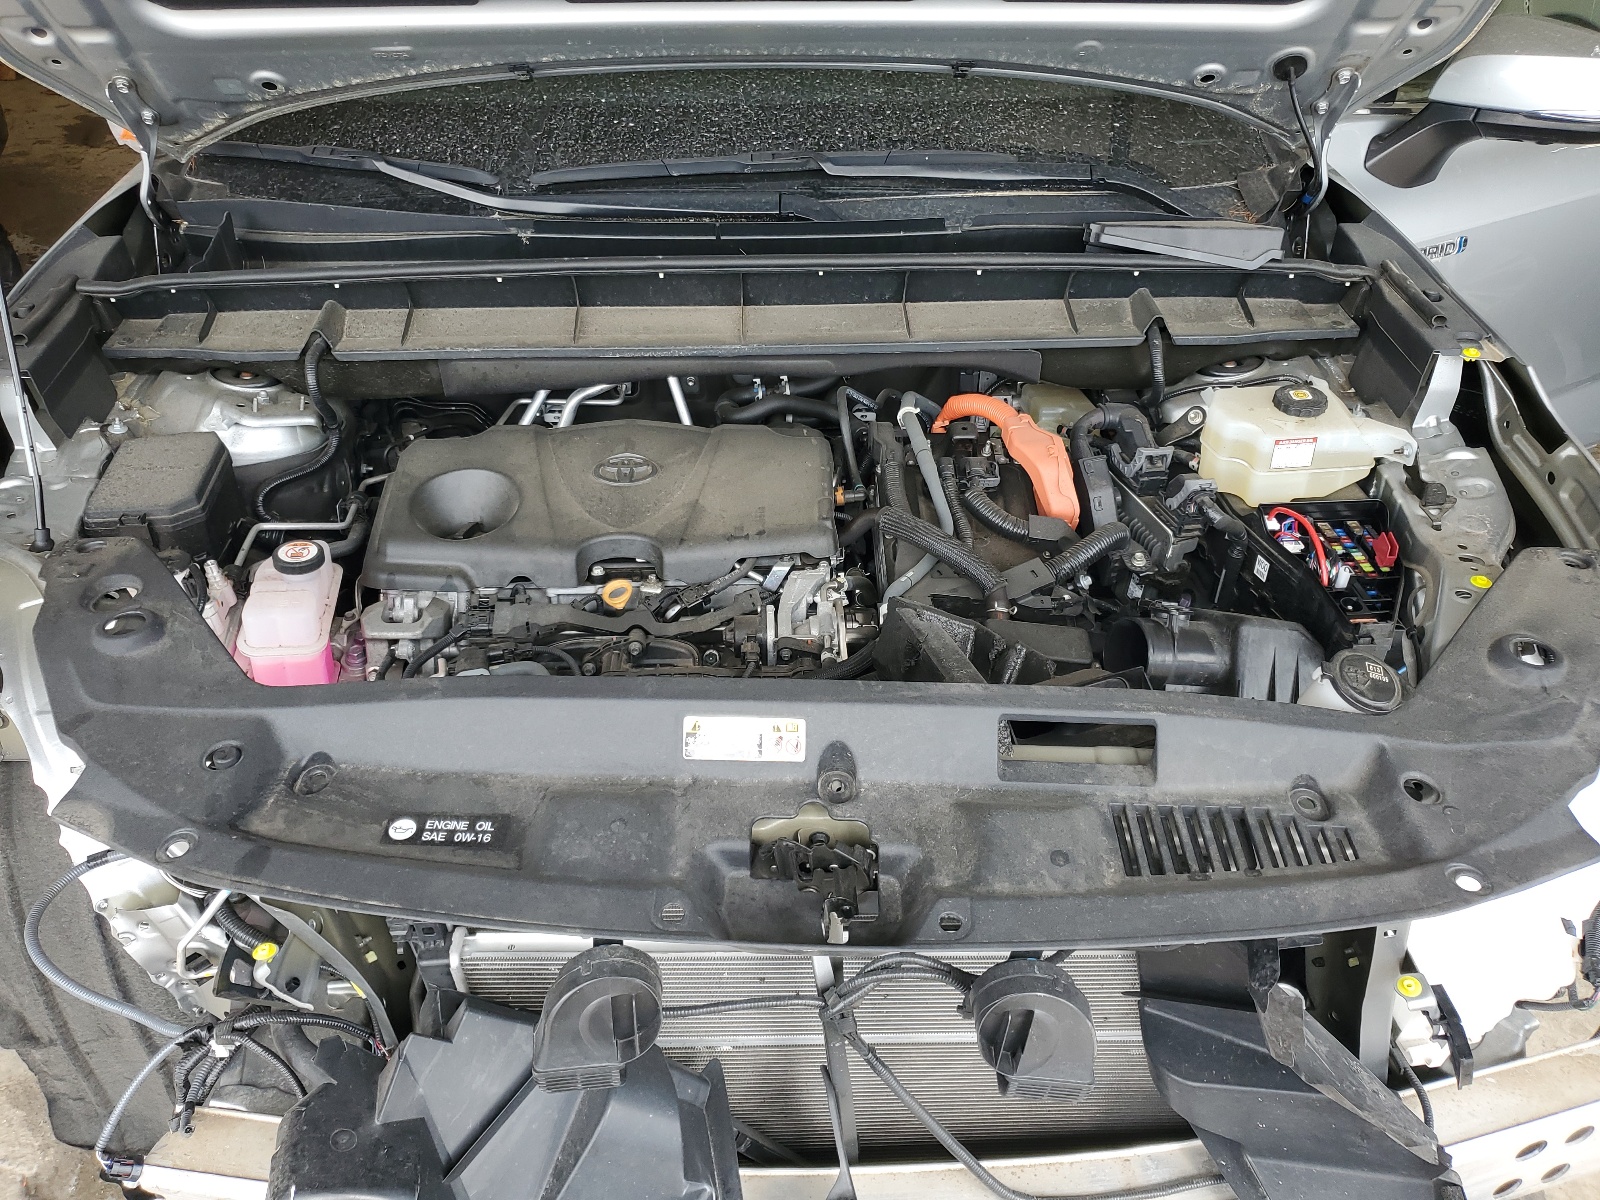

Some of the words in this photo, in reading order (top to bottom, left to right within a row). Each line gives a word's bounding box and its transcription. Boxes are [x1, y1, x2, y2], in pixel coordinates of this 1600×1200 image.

[425, 820, 469, 831] ENGINE
[475, 821, 495, 831] OIL
[421, 831, 447, 842] SAE
[453, 832, 491, 843] 0W-16
